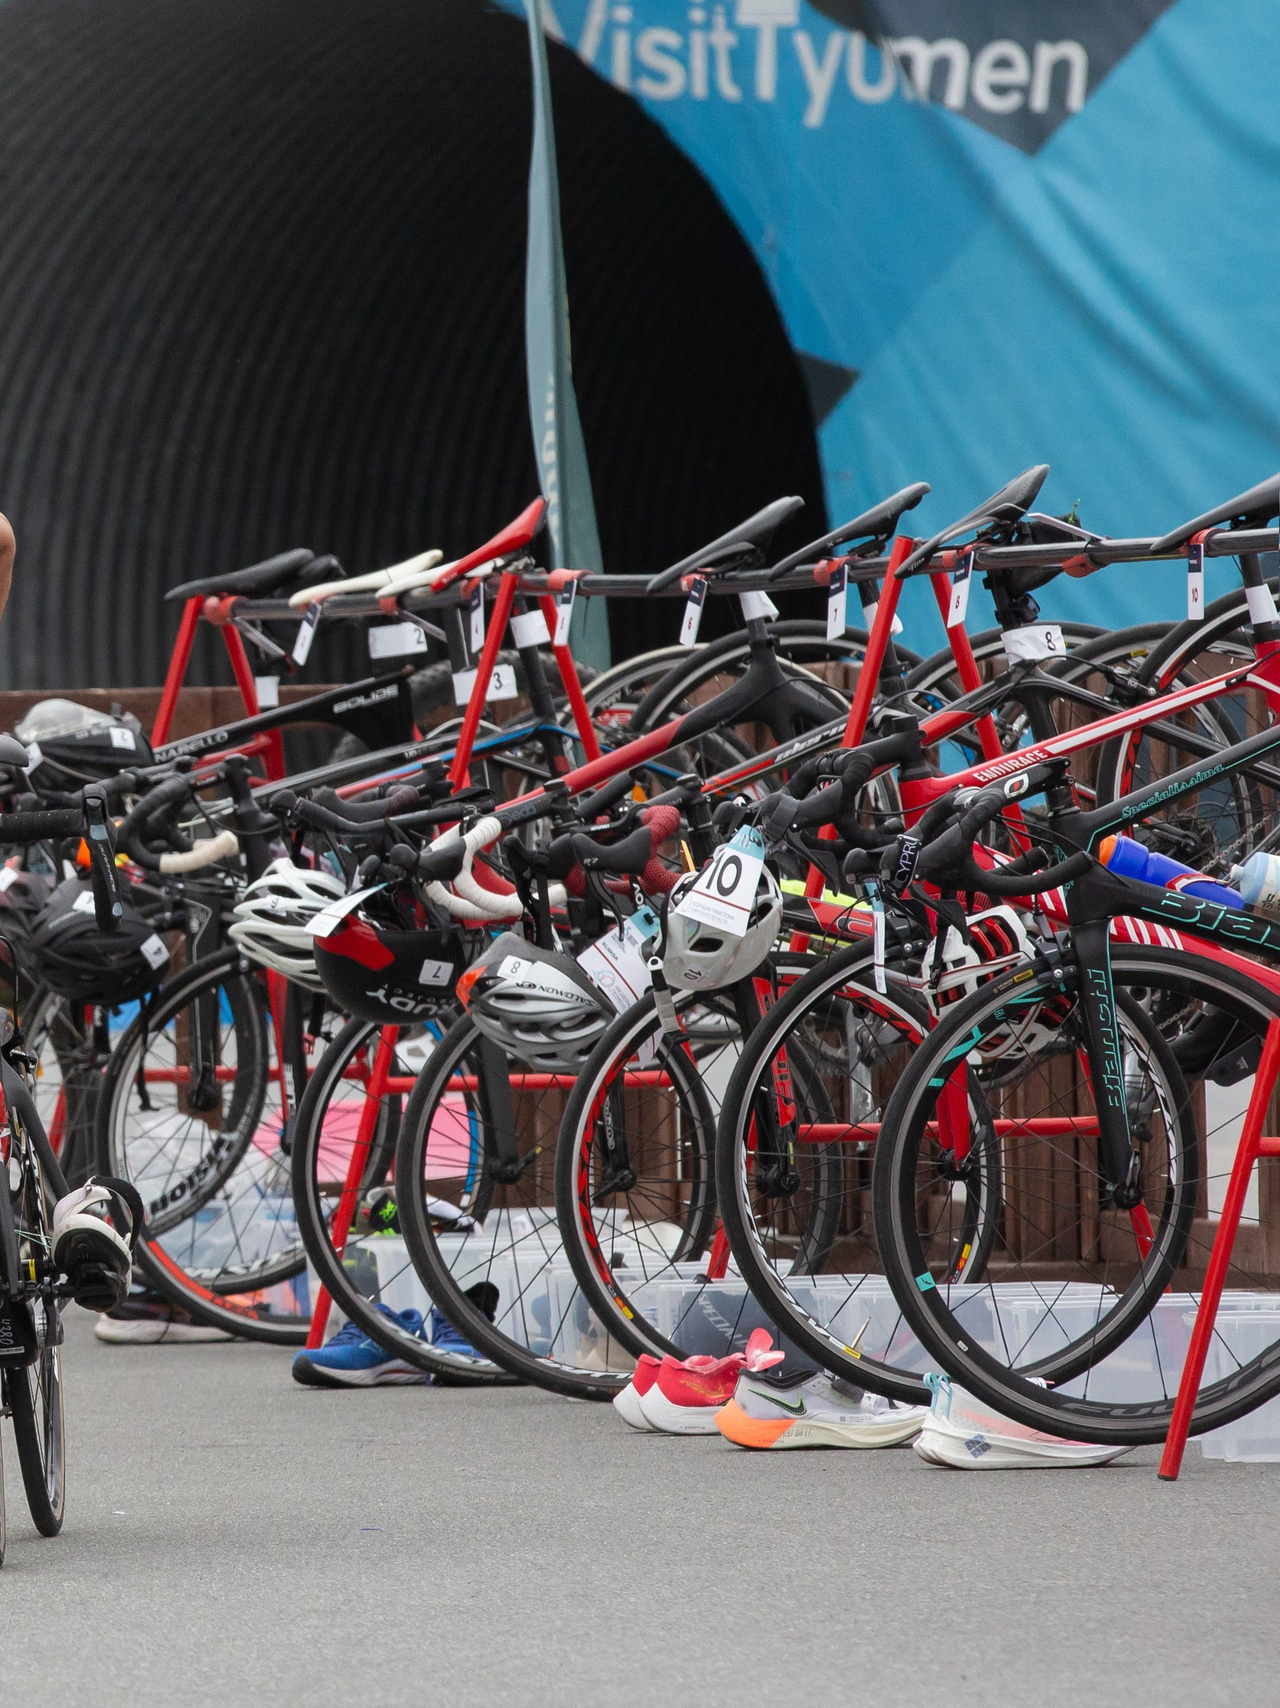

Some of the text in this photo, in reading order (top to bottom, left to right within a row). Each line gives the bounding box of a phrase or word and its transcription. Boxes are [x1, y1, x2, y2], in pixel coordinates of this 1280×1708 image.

[413, 627, 425, 645] 2
[1044, 631, 1056, 650] 8
[493, 672, 502, 690] 3
[332, 684, 400, 714] BOLIDE
[972, 750, 1049, 783] ENDURACE
[1122, 763, 1225, 818] Specialissima
[705, 854, 743, 897] 10
[510, 961, 521, 974] 8
[538, 984, 595, 1007] SALOMON
